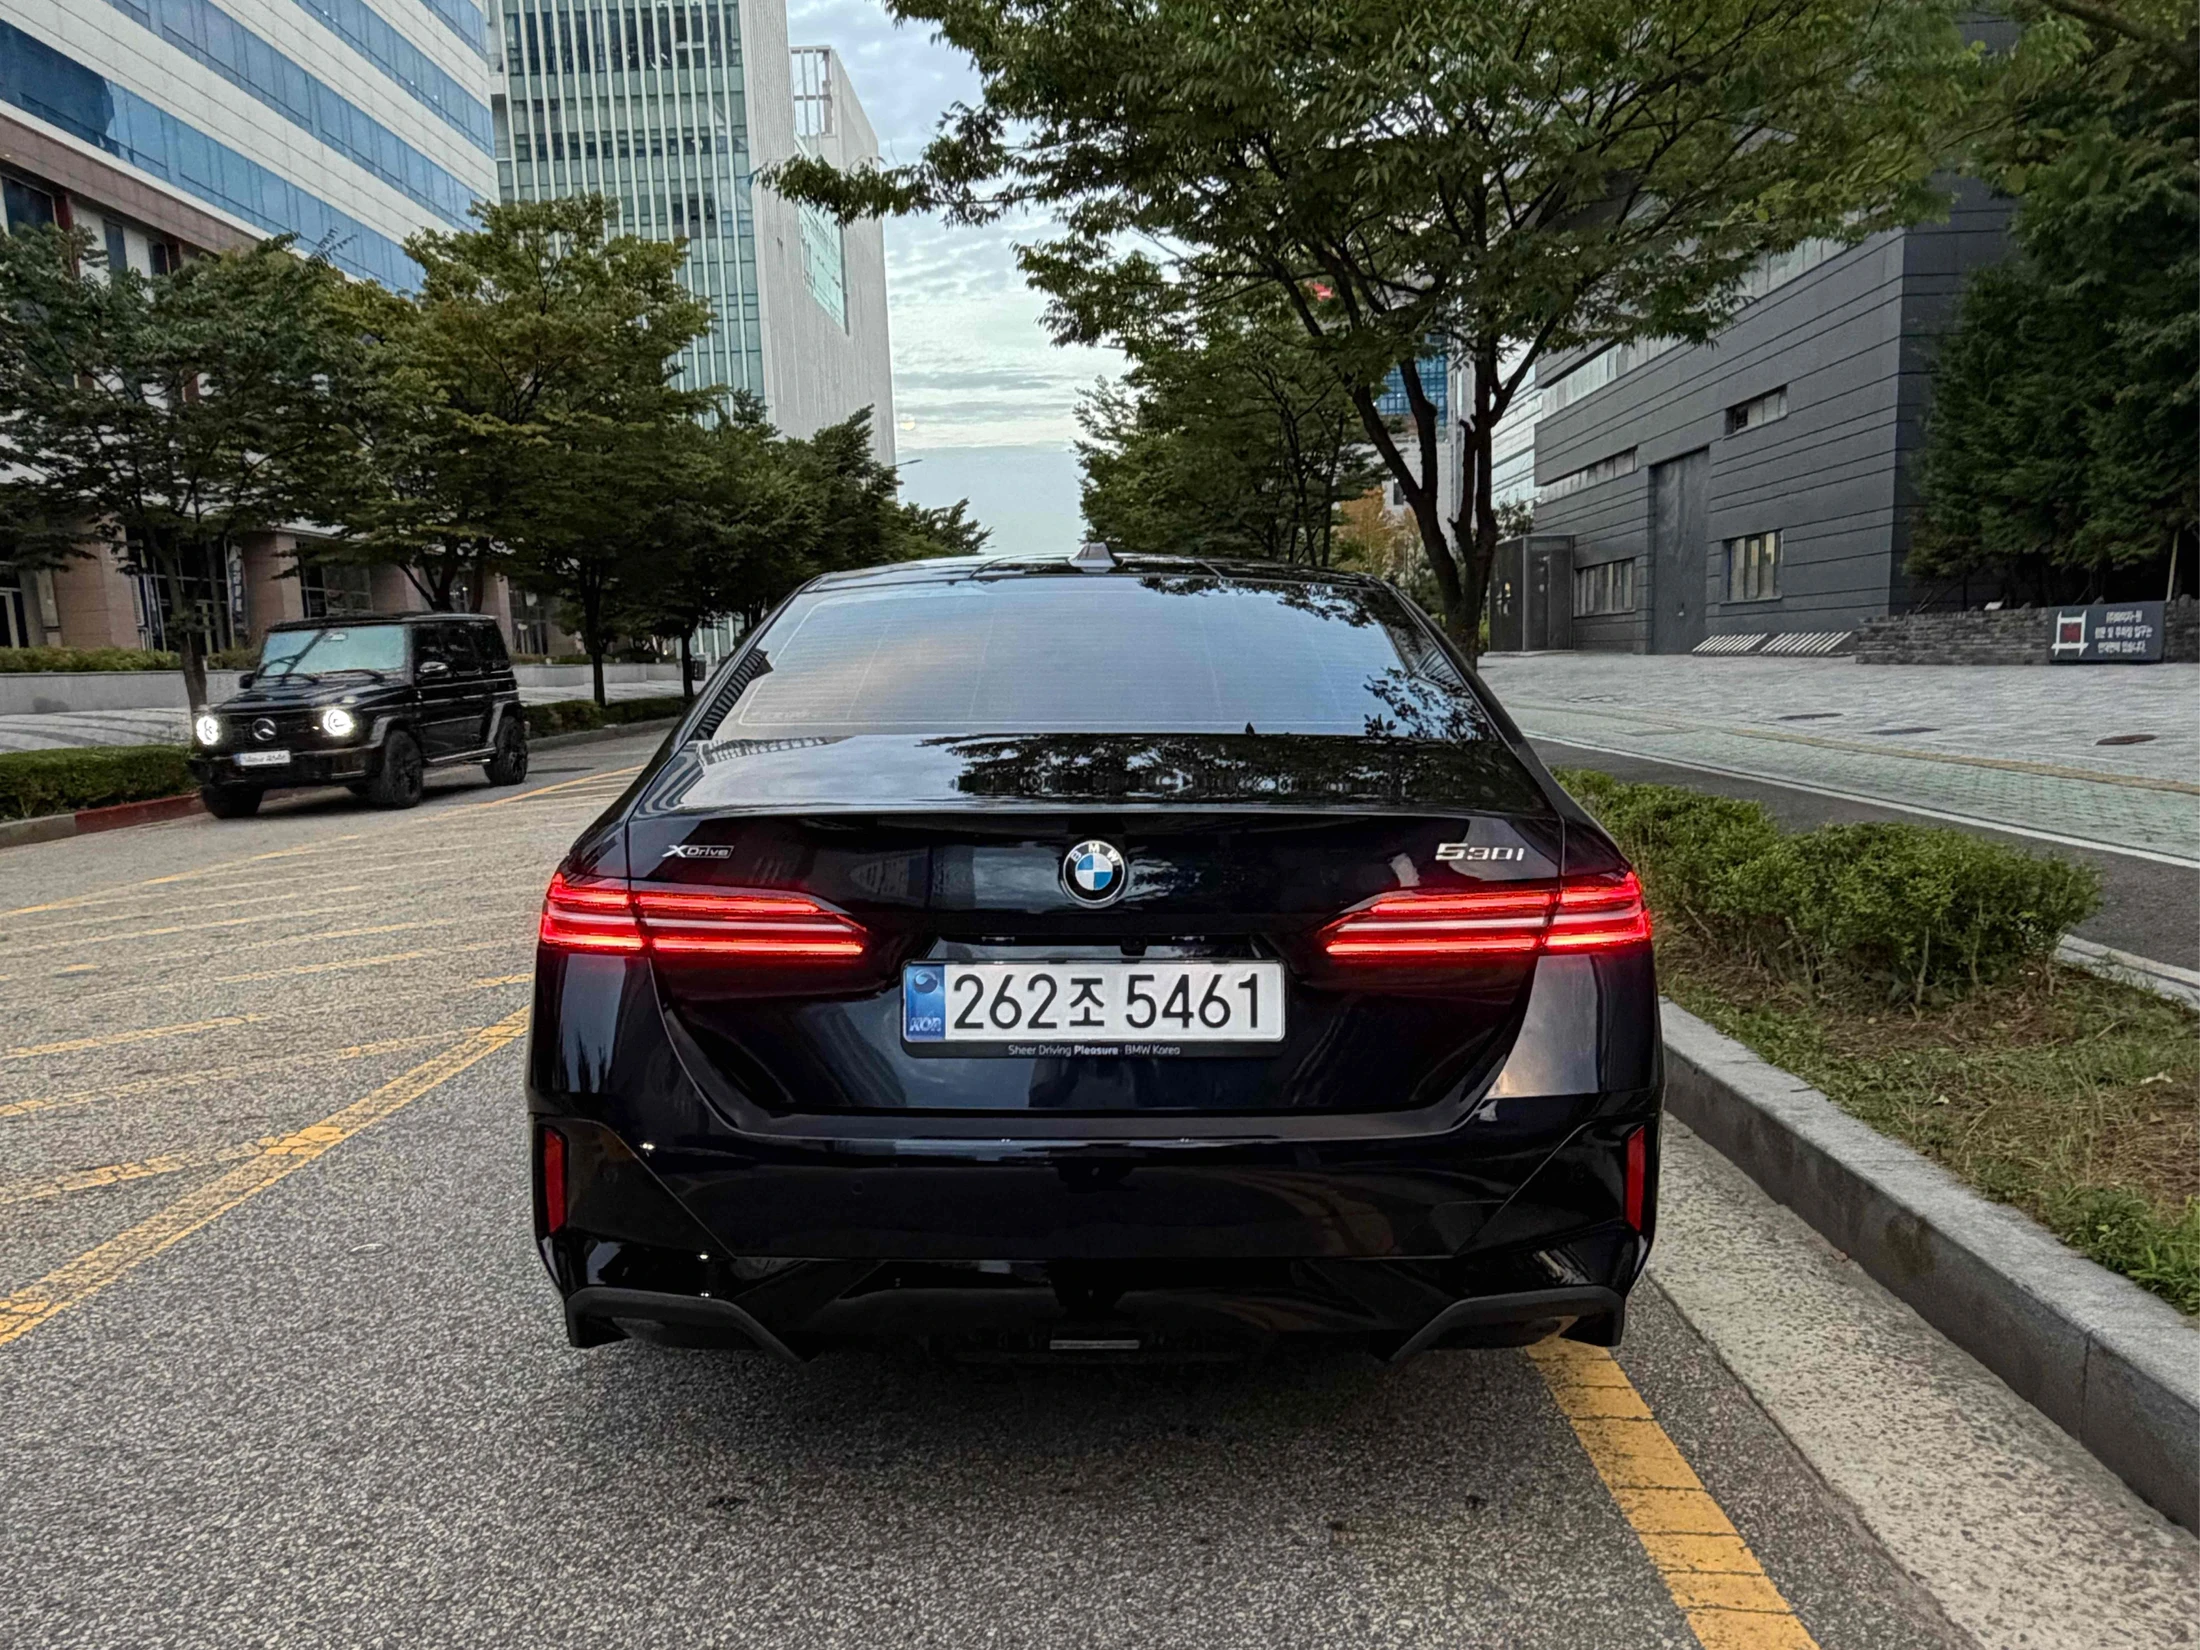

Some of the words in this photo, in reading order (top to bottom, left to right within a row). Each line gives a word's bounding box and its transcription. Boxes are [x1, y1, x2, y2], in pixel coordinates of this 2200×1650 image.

[1070, 842, 1121, 866] BMW
[953, 973, 1105, 1030] 262조
[1125, 973, 1259, 1029] 5461
[909, 1016, 942, 1032] KOR
[1008, 1045, 1036, 1056] Sheer
[1038, 1045, 1072, 1057] Driving
[1074, 1045, 1119, 1056] Pleasure
[1124, 1045, 1151, 1056] BMW
[1152, 1045, 1181, 1056] Korea
